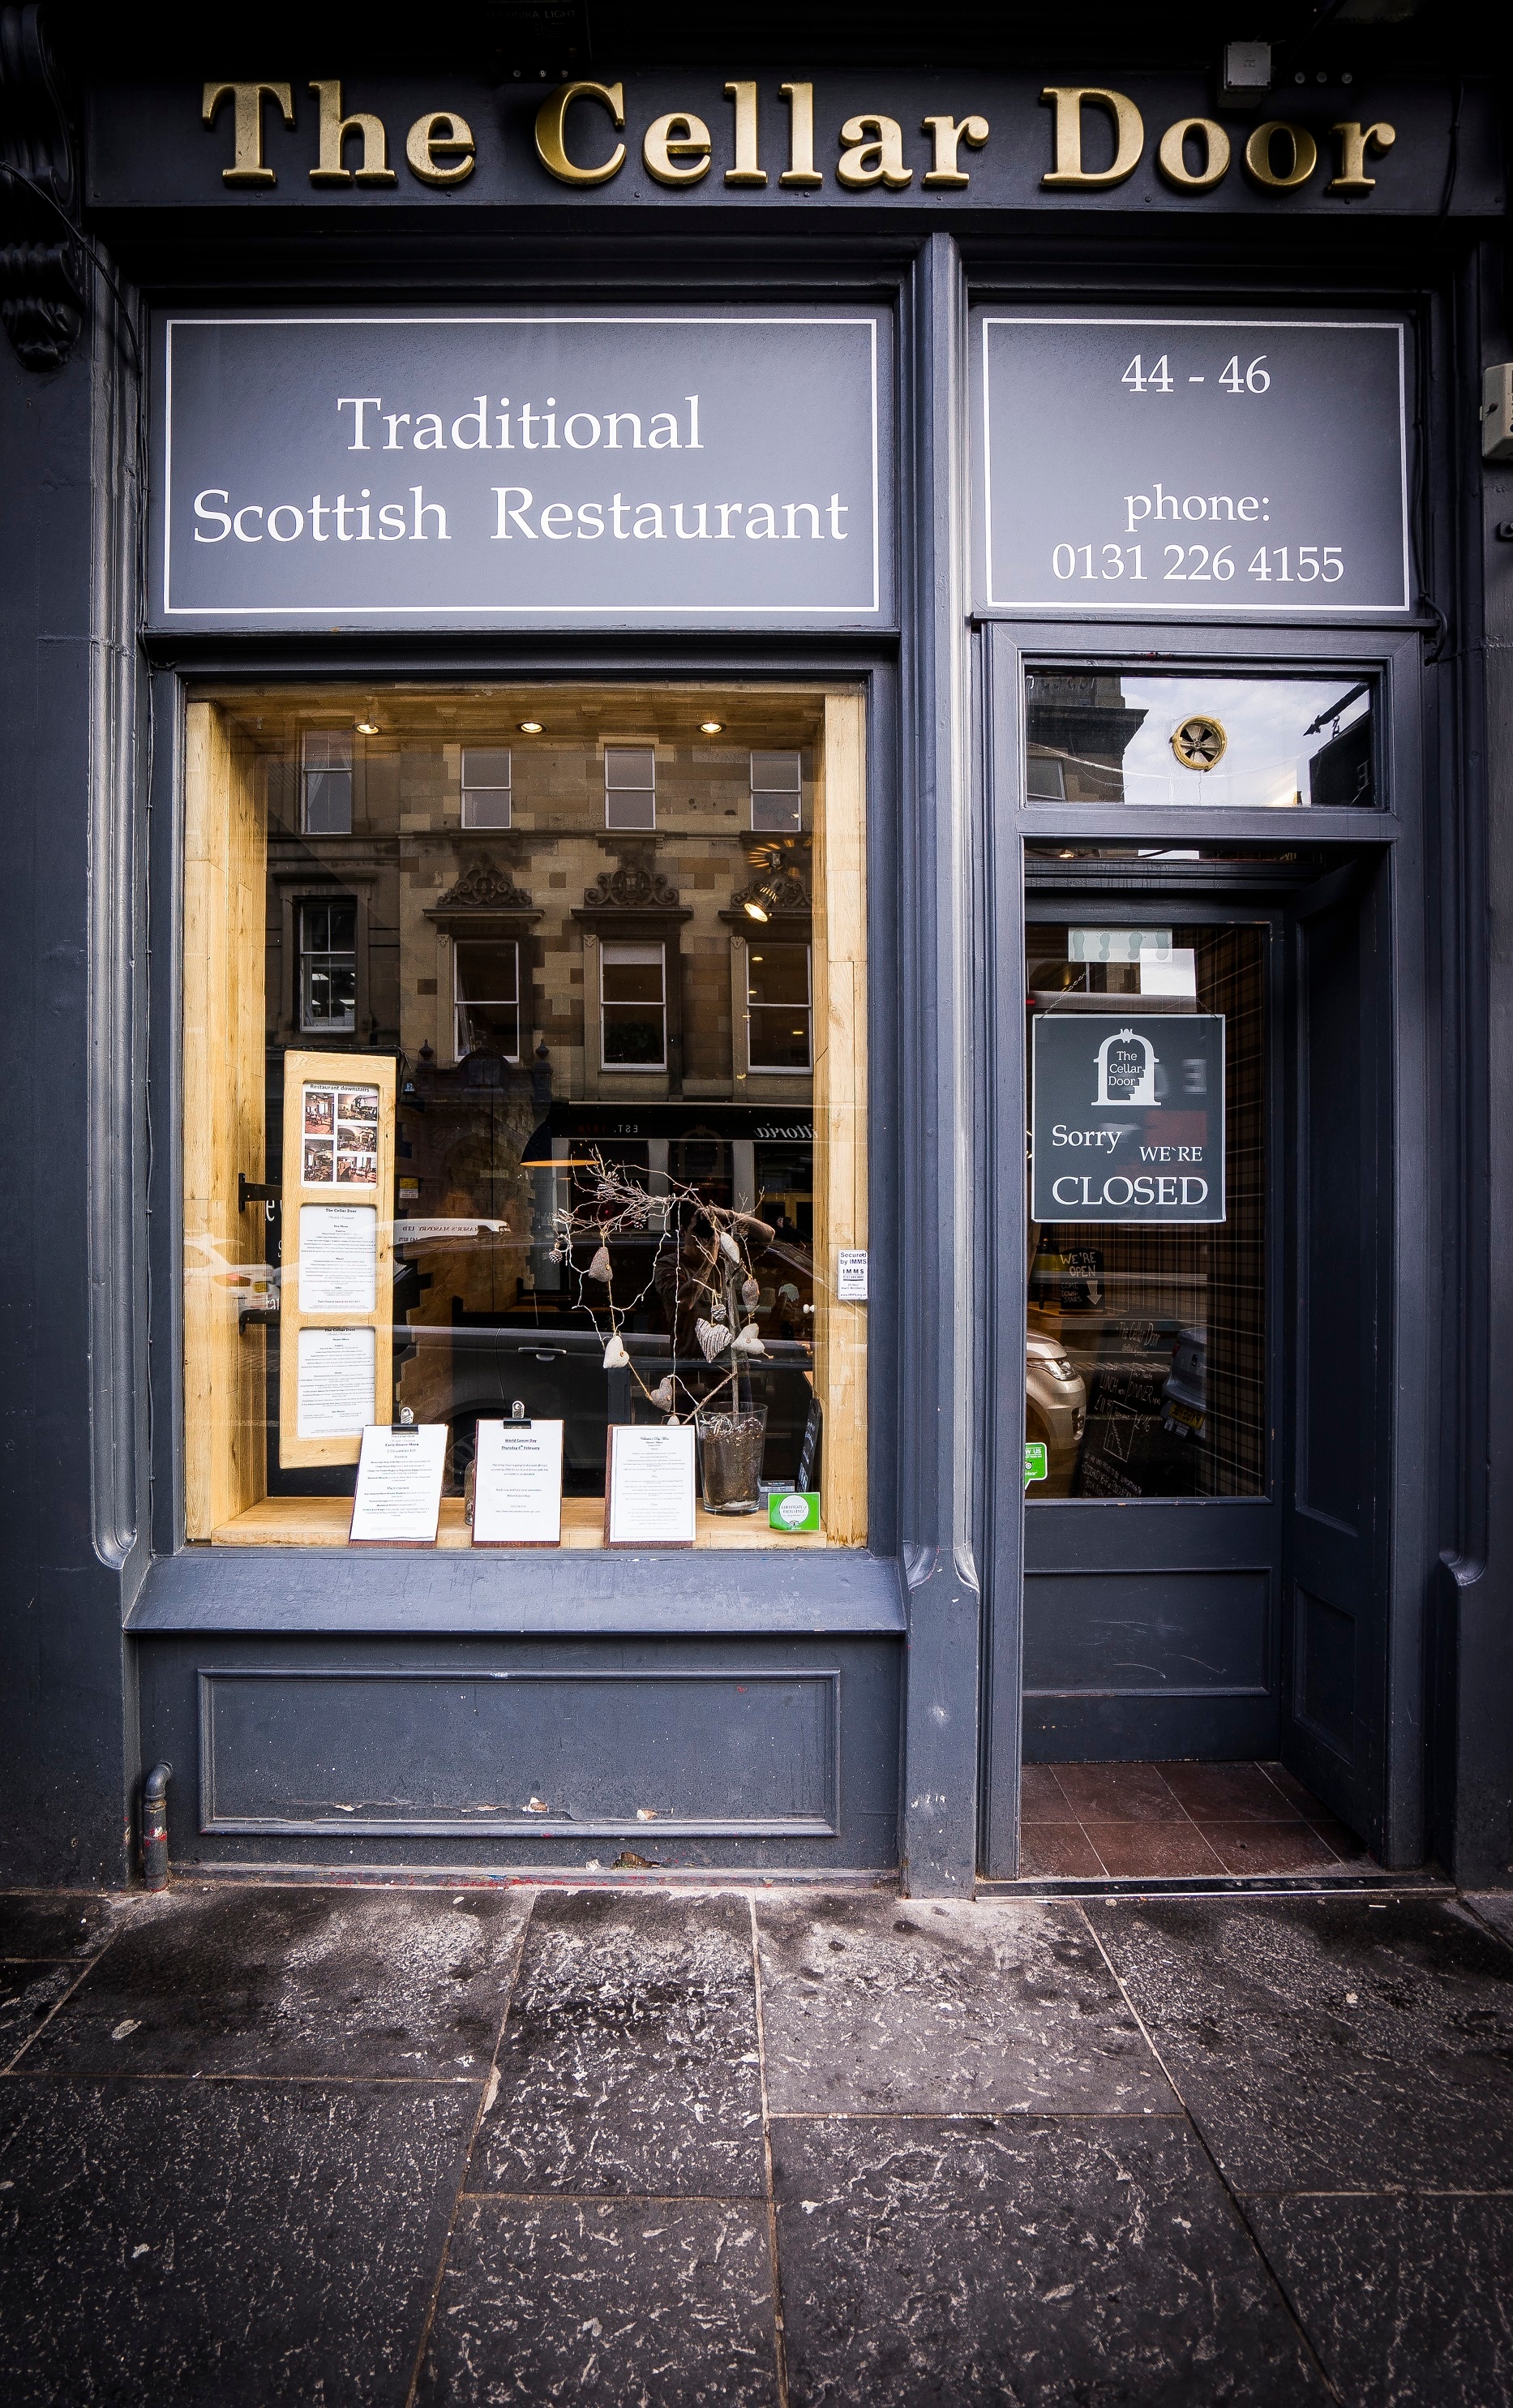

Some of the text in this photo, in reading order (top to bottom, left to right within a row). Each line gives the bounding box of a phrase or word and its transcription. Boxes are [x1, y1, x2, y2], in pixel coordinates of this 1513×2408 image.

[545, 10, 576, 19] LIGHT
[201, 79, 1396, 194] The Cellar Door
[1121, 354, 1173, 392] 44
[1219, 355, 1270, 393] 46
[338, 395, 704, 449] Traditional
[195, 486, 848, 542] Scottish Restaurant
[1124, 483, 1269, 532] phone:
[1052, 543, 1344, 582] 0131 226 4155
[1108, 1049, 1142, 1087] The Cellar Door
[1052, 1124, 1122, 1155] Sorry
[1052, 1175, 1208, 1206] CLOSED
[1060, 1251, 1097, 1265] WE'RE
[1069, 1264, 1096, 1277] OPEN
[1099, 1371, 1119, 1394] LUNCH
[1128, 1381, 1154, 1403] DINNER
